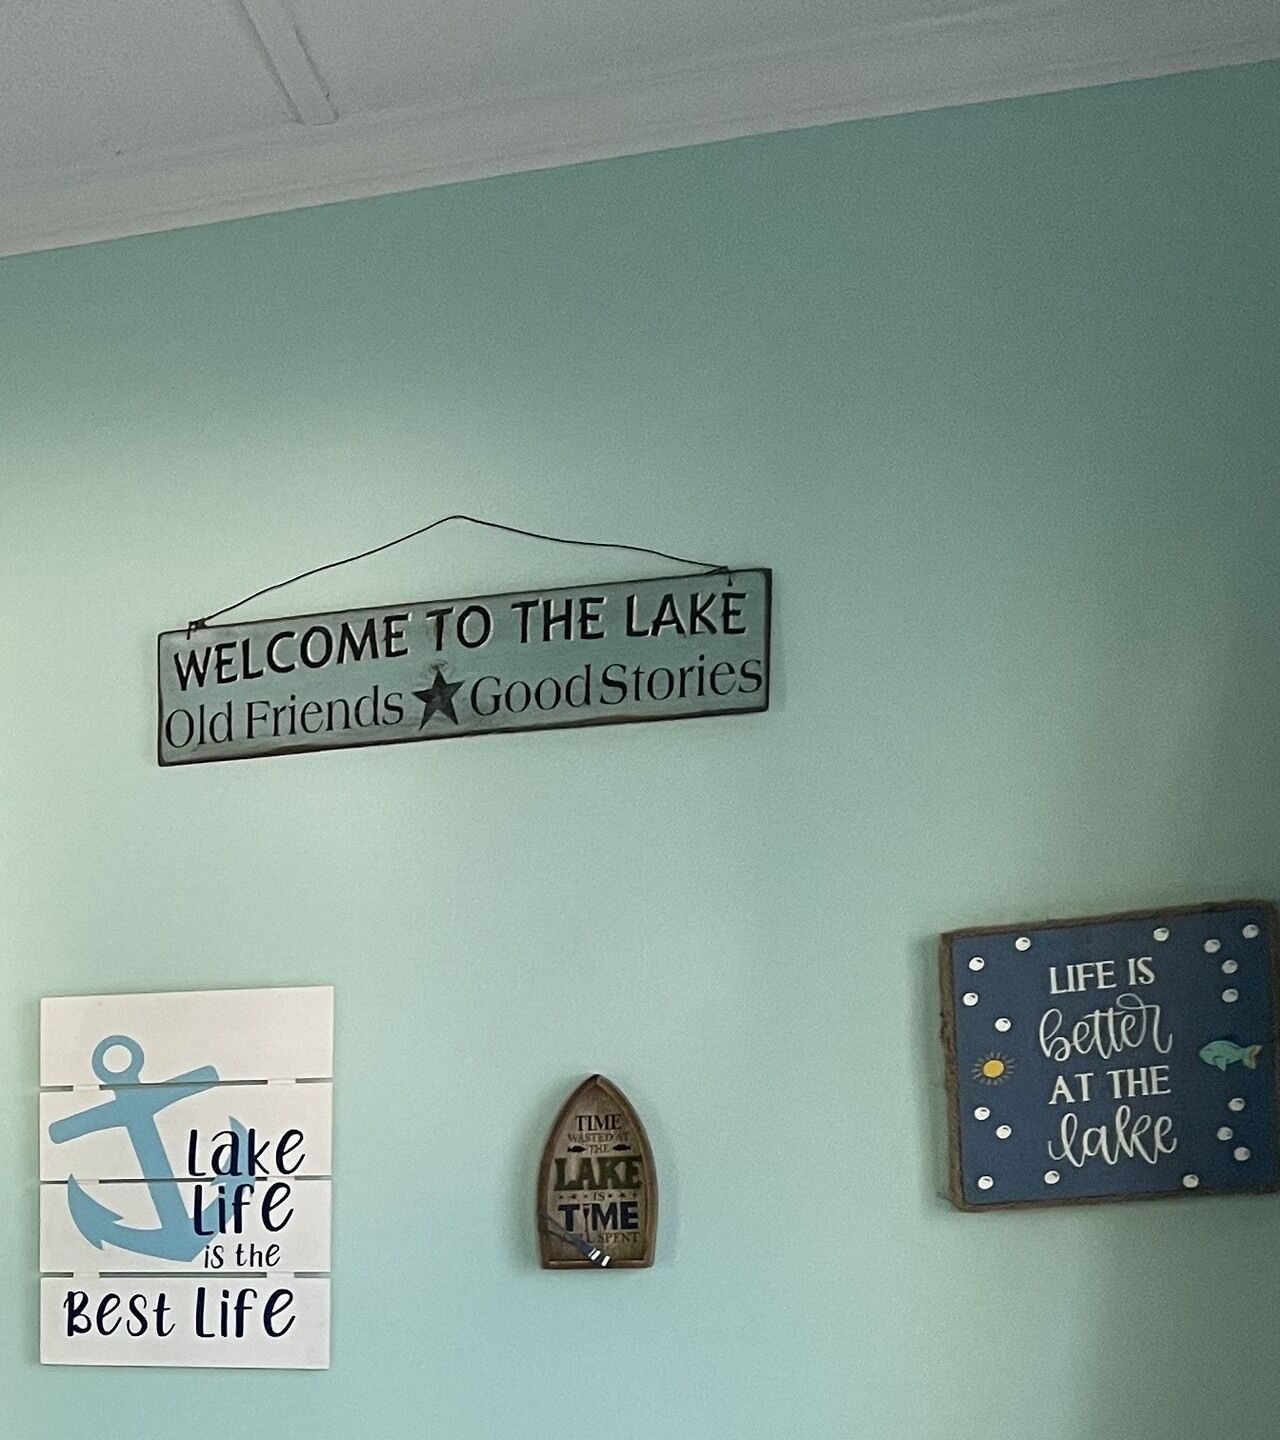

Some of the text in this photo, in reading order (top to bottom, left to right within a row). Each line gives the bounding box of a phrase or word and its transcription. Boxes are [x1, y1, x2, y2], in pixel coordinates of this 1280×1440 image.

[172, 590, 747, 692] WELCOME TO THE LAKE
[164, 655, 763, 751] Old Friends Good Stories
[1048, 957, 1155, 995] LIFE IS
[1039, 992, 1173, 1061] better
[1048, 1065, 1171, 1105] AT THE
[575, 1113, 622, 1131] TIME
[1047, 1104, 1178, 1168] lake
[187, 1128, 306, 1177] Lake
[553, 1154, 644, 1191] LAKE
[192, 1181, 295, 1237] Life
[557, 1200, 639, 1232] TIME
[593, 1191, 606, 1201] IS
[204, 1243, 281, 1269] is the
[63, 1286, 296, 1338] Best Life
